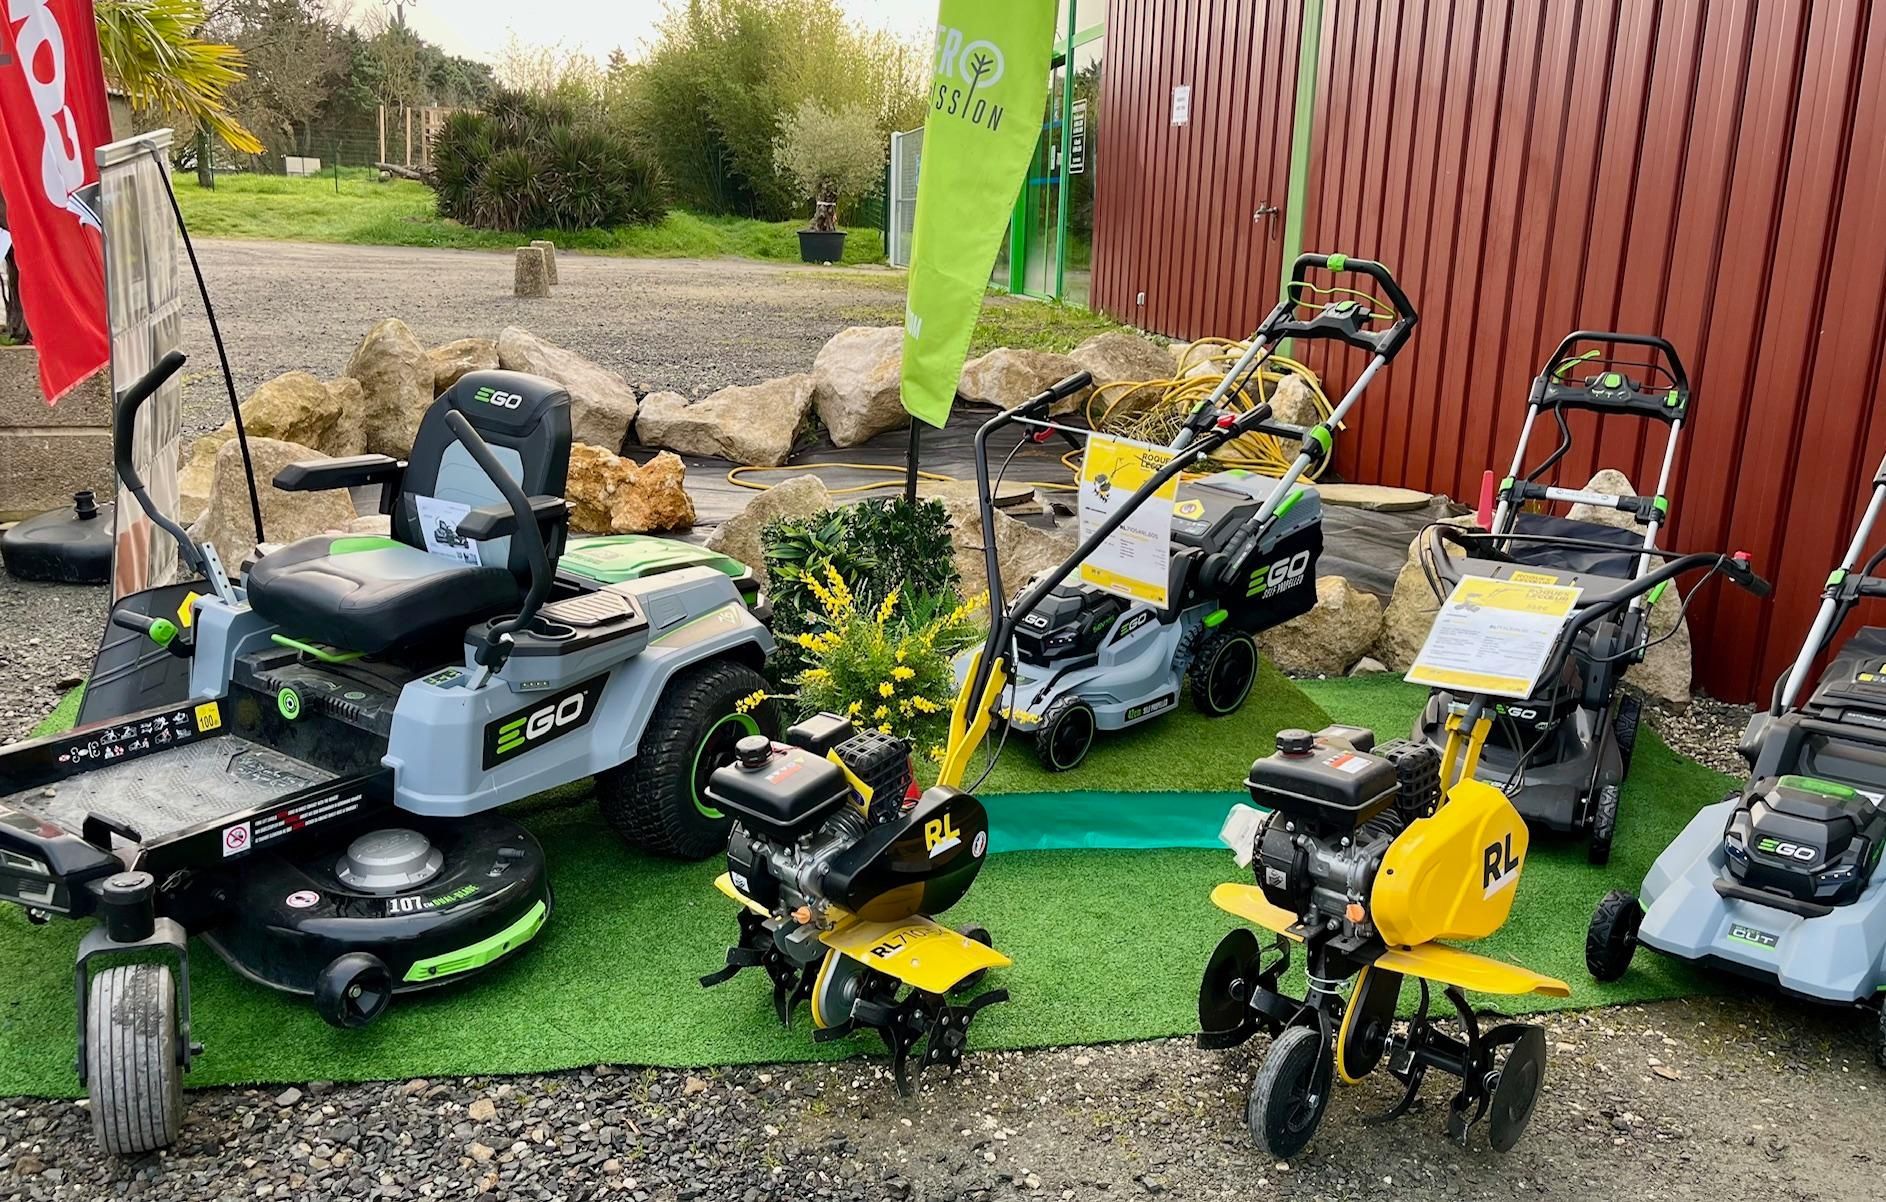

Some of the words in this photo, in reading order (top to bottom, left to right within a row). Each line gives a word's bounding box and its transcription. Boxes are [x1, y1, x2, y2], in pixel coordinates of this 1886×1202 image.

[474, 386, 523, 410] EGO
[1141, 452, 1171, 465] ROQUE
[1246, 549, 1310, 598] EGO
[1023, 613, 1048, 628] GO
[1119, 612, 1147, 636] EGO
[1495, 703, 1537, 720] EGO
[496, 692, 585, 755] EGO
[924, 813, 961, 853] RL
[1483, 832, 1519, 890] RL
[1757, 838, 1816, 861] EGO
[389, 895, 423, 913] 107
[1732, 928, 1774, 944] CUT
